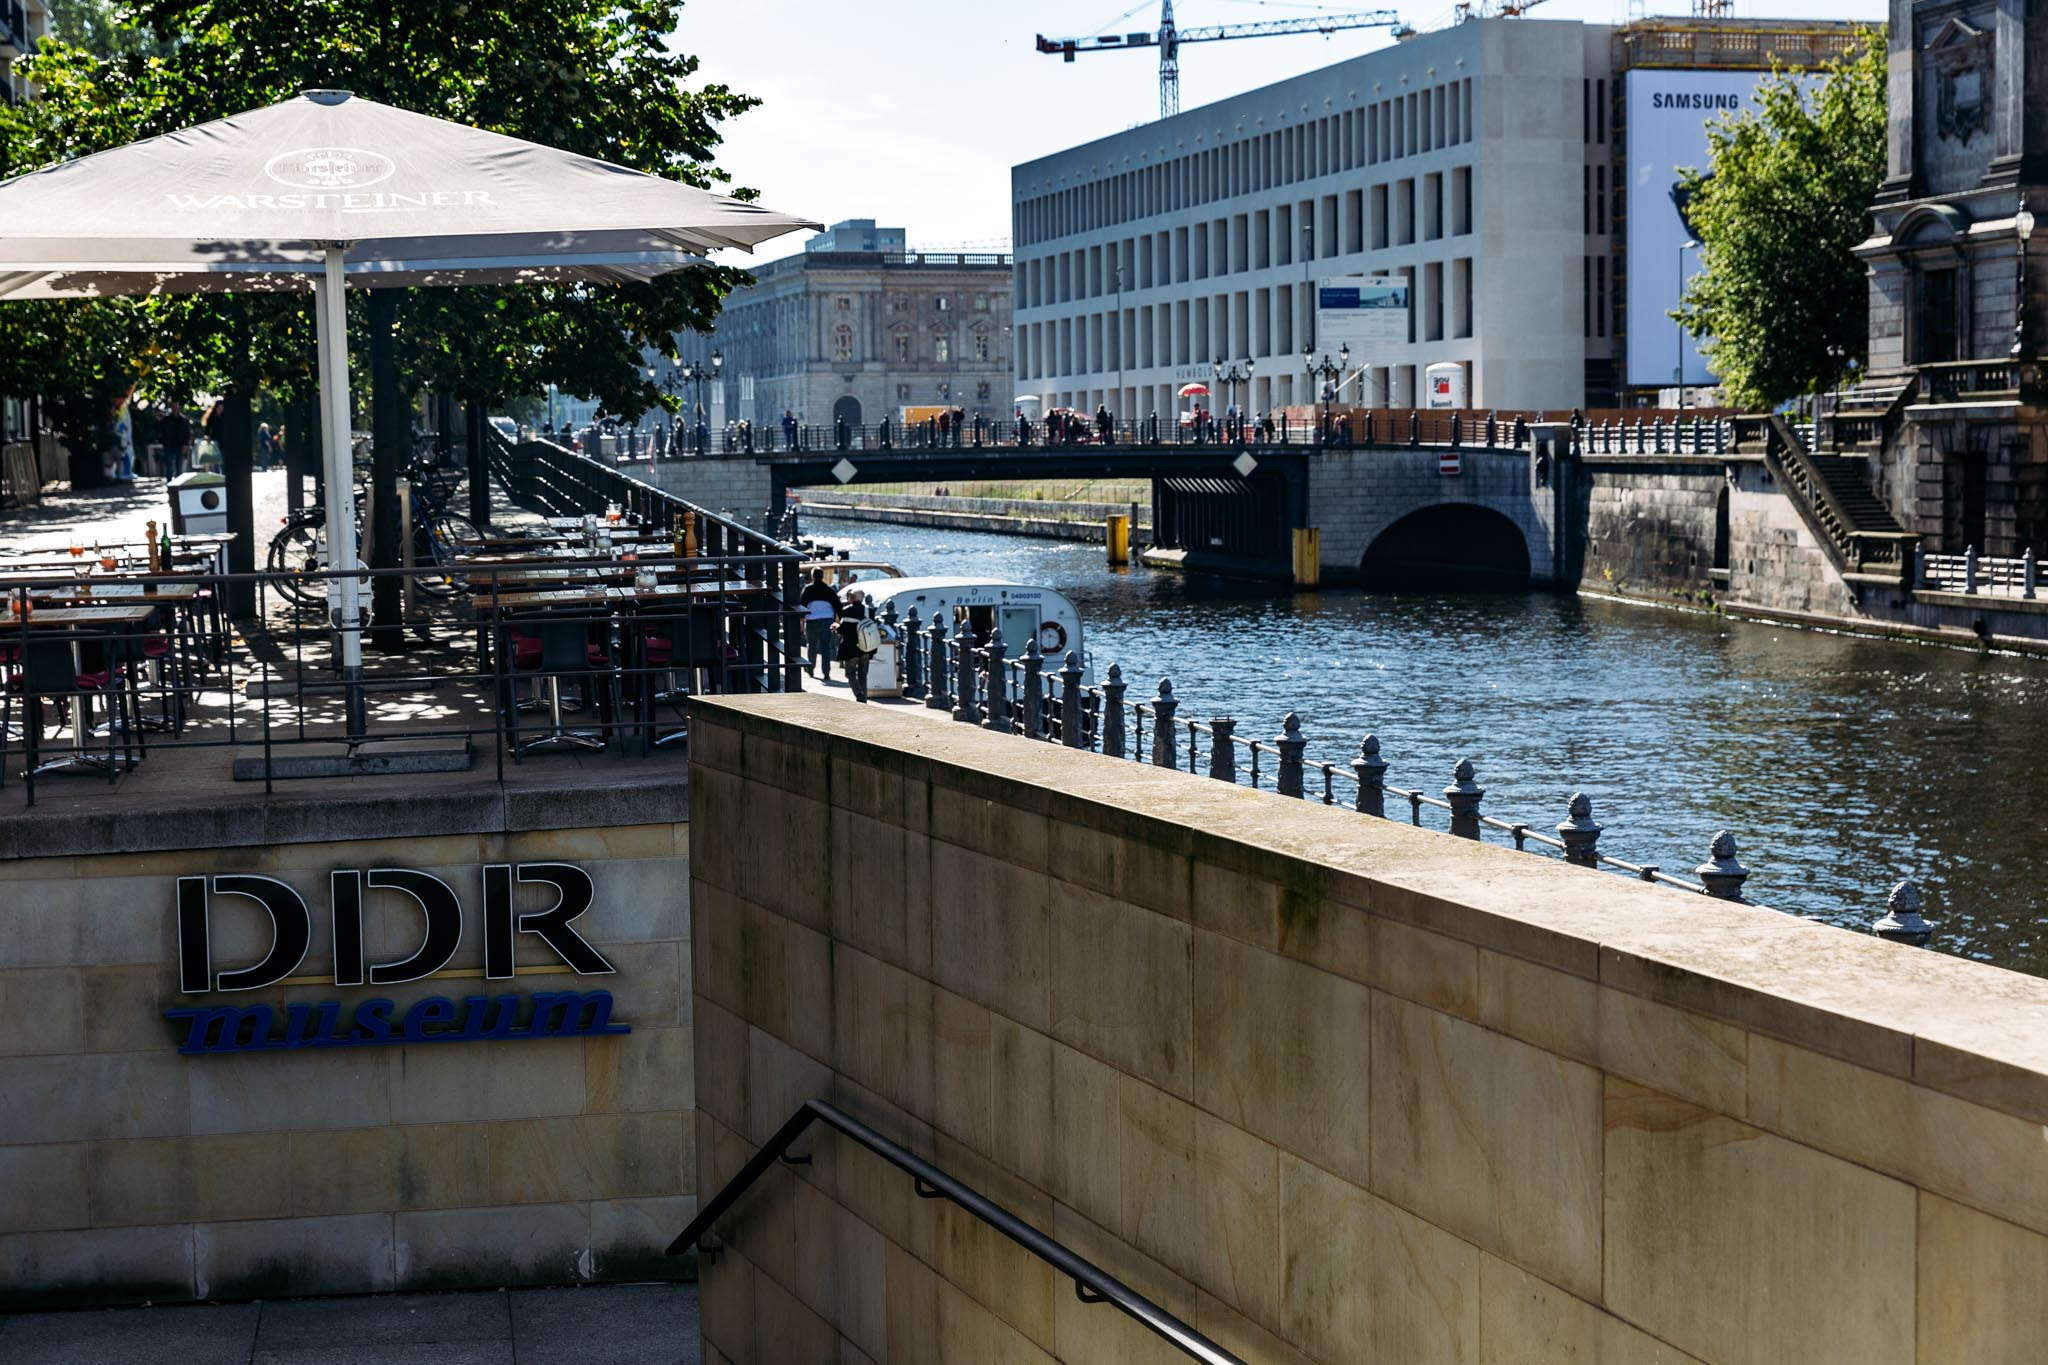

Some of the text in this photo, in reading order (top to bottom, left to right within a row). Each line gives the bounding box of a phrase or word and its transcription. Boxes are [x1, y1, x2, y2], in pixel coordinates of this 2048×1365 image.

[1652, 92, 1739, 110] SAMSUNG
[167, 189, 499, 210] WARSTEINER
[1176, 366, 1214, 379] HUMBOLD
[956, 596, 994, 604] Berlin
[970, 587, 978, 596] D
[176, 862, 617, 994] DDR
[164, 989, 632, 1056] museum
